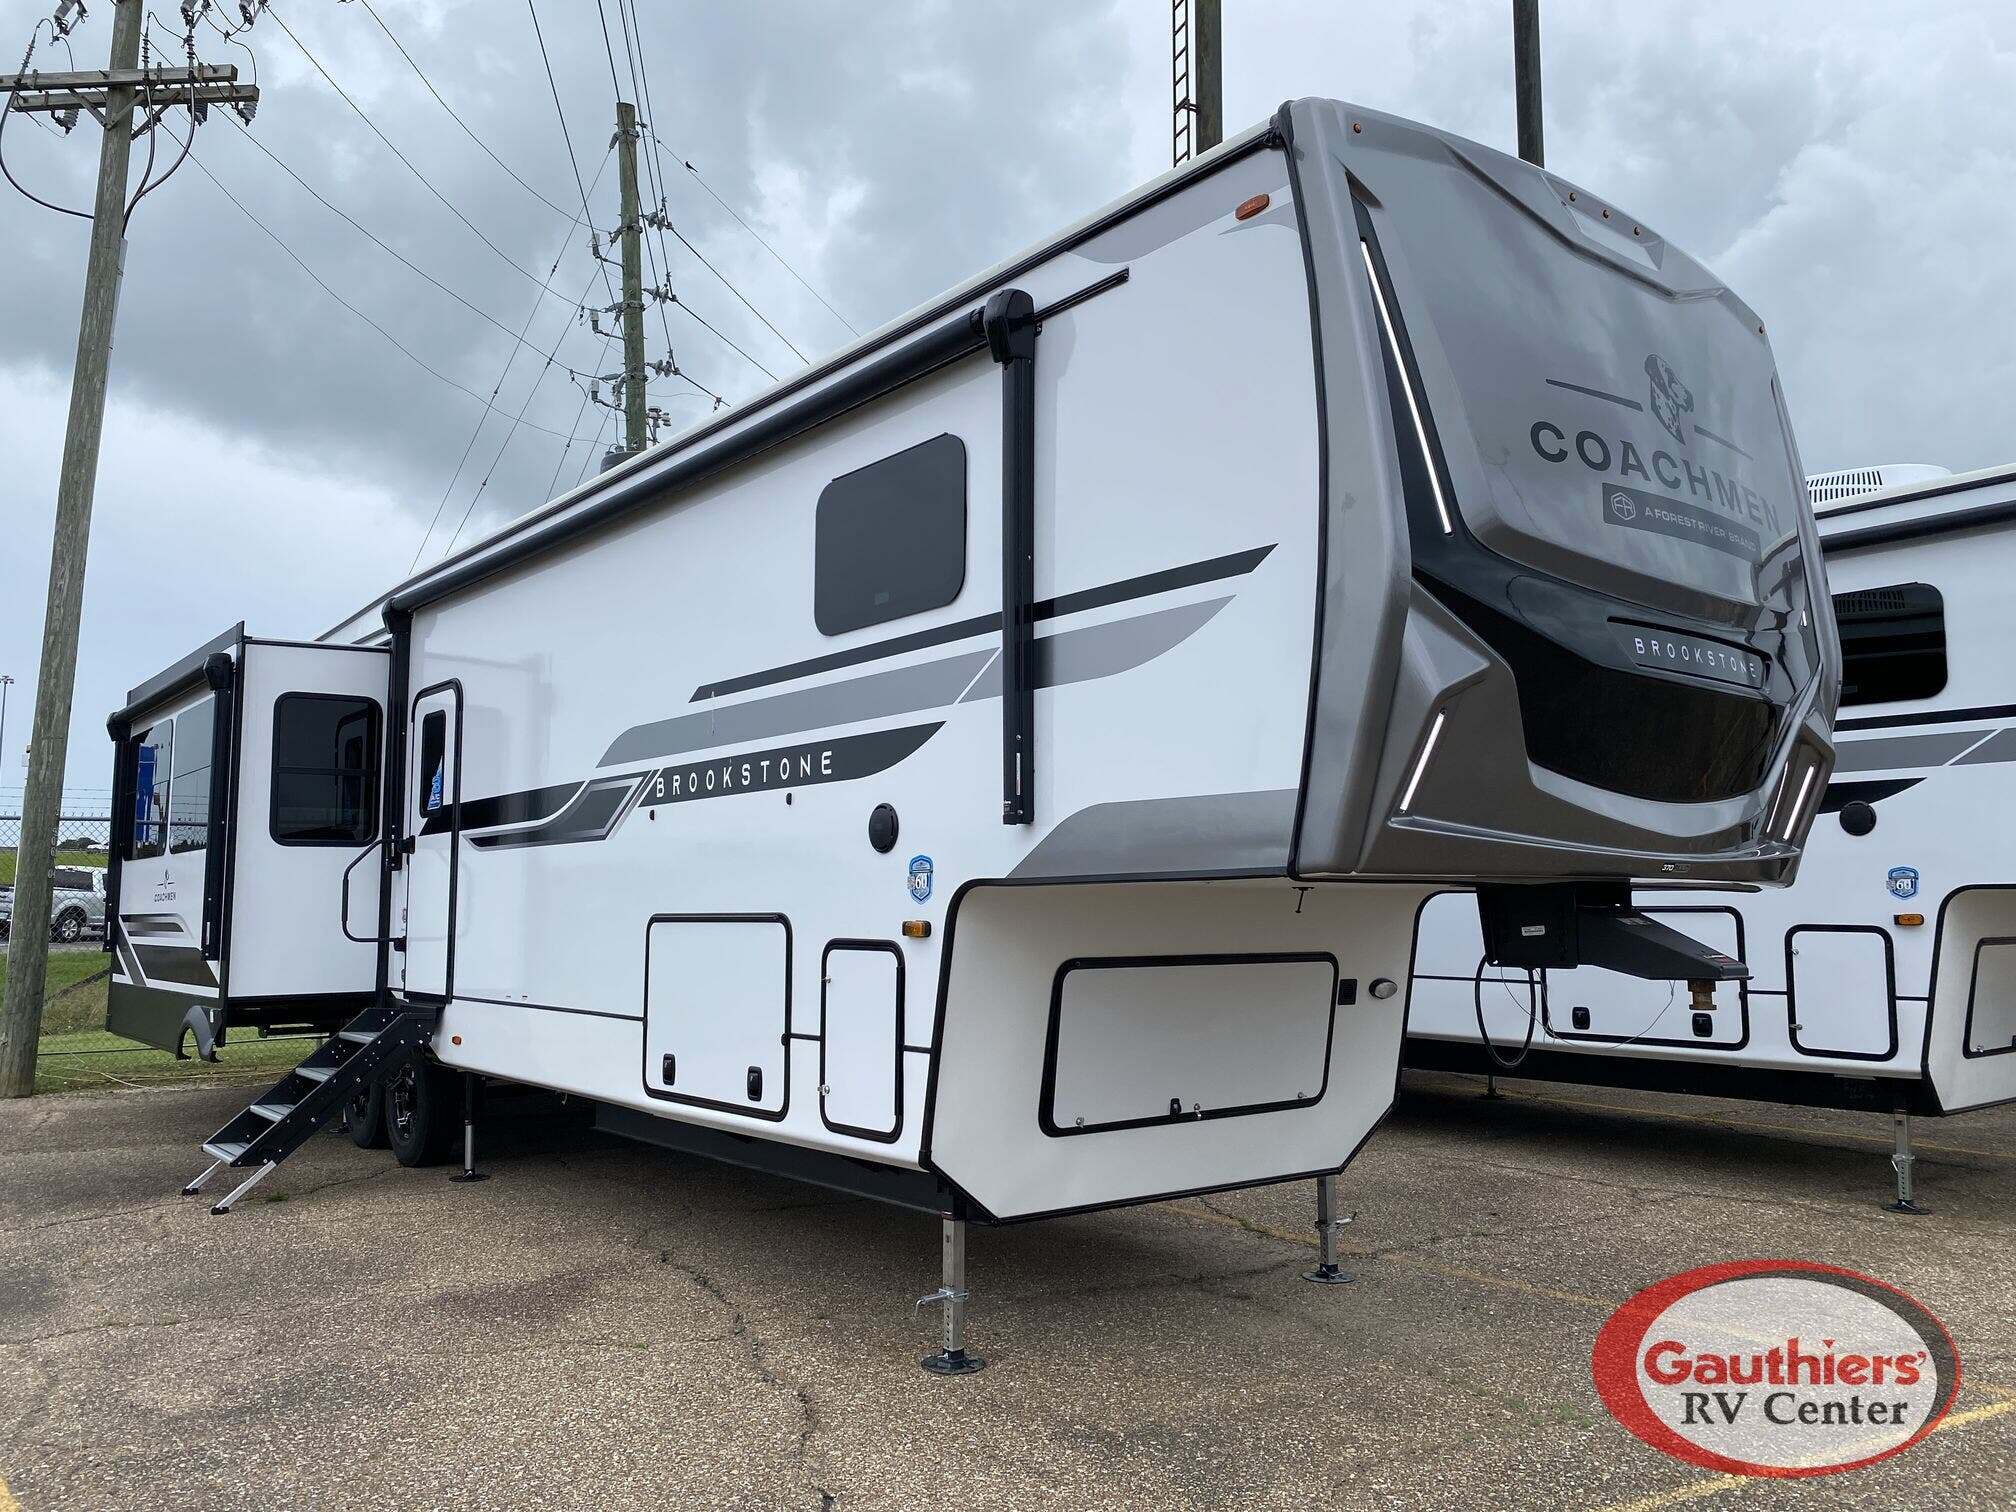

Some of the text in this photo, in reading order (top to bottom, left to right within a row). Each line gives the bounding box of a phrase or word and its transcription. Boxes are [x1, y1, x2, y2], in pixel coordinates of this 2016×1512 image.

[1530, 420, 1782, 539] COACHMEN
[1644, 506, 1654, 518] A
[1654, 509, 1696, 528] FOREST
[1698, 521, 1727, 538] RIVER
[1634, 637, 1758, 678] BROOKSTONE
[656, 750, 833, 799] BROOKSTONE
